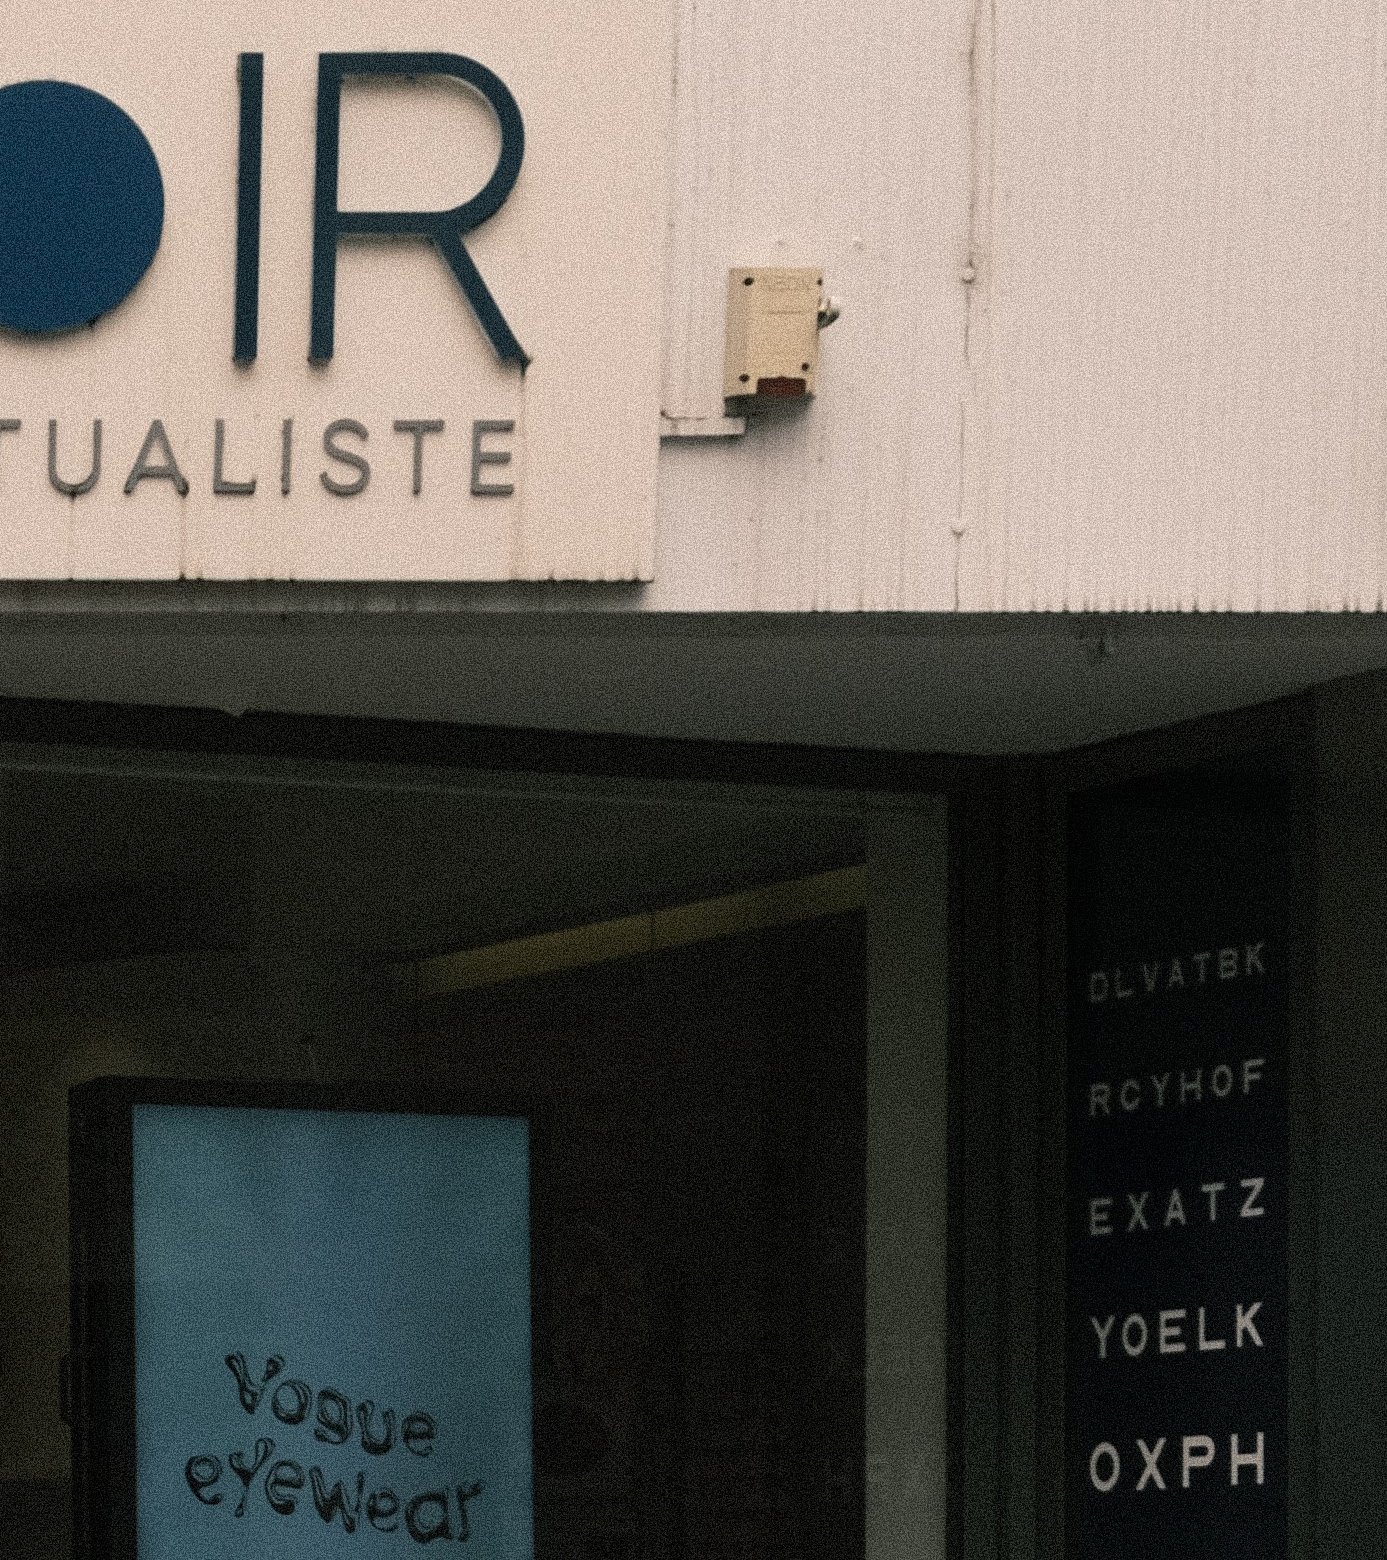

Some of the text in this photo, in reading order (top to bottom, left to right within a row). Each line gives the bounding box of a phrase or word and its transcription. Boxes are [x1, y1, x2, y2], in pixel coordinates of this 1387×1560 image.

[1089, 942, 1265, 1004] DLVATBK
[1089, 1058, 1265, 1117] RCYHOF
[1089, 1176, 1265, 1236] EXATZ
[1089, 1301, 1264, 1359] YOELK
[226, 1351, 437, 1458] Vogue
[1089, 1431, 1265, 1493] OXPH
